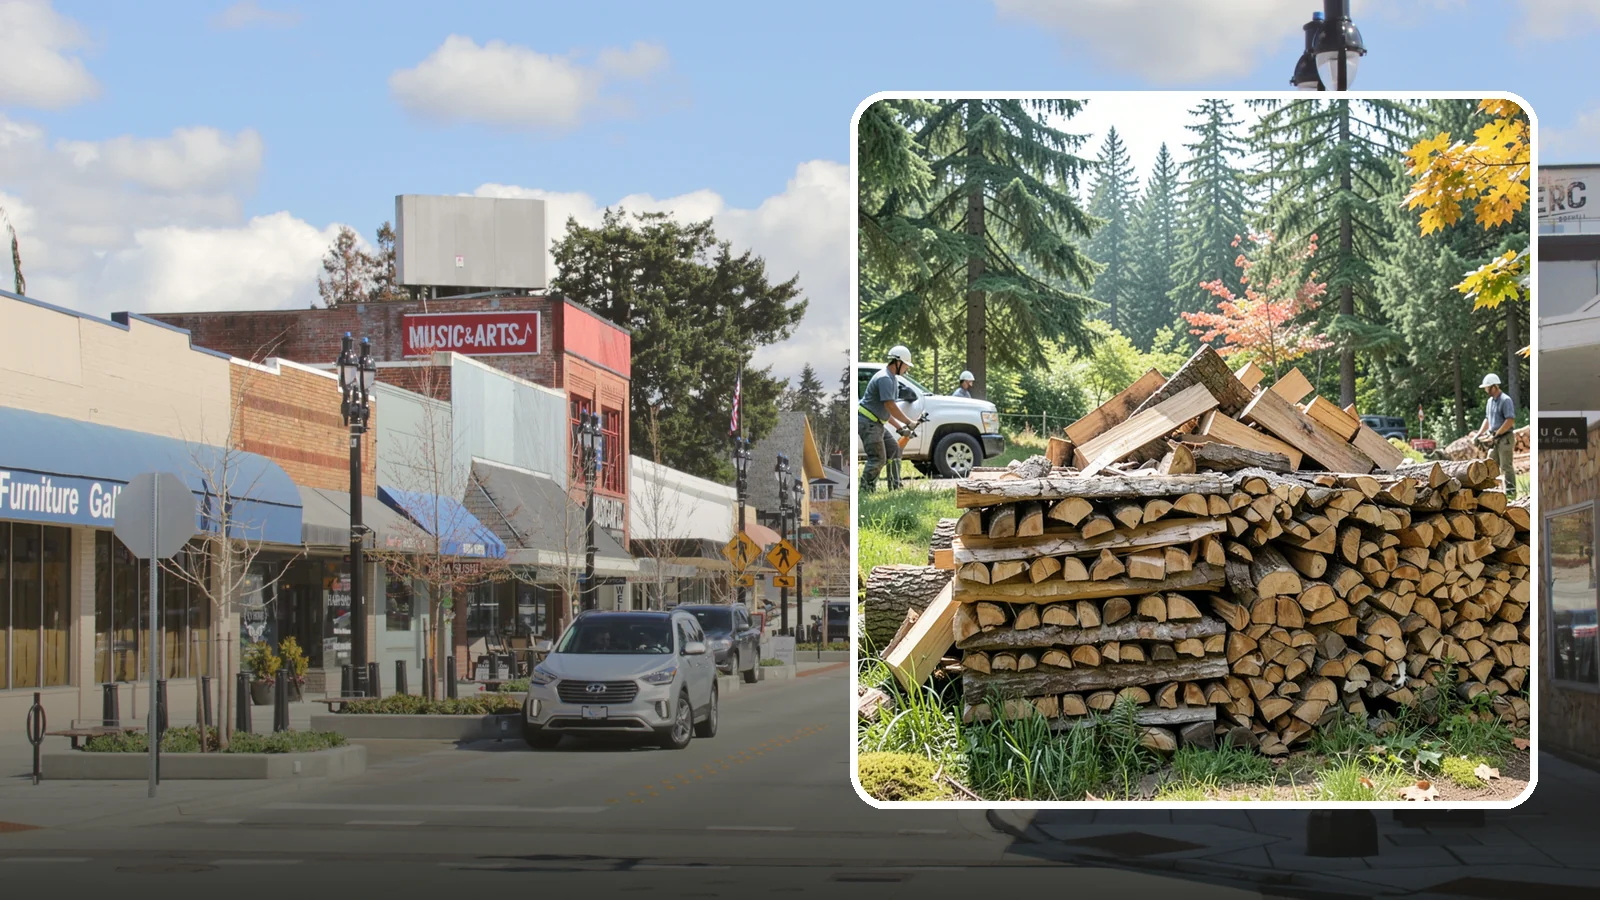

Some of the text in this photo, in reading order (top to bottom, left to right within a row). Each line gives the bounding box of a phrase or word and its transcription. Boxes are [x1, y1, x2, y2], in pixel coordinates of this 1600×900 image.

[0, 471, 121, 519] Furniture Gal
[453, 564, 479, 574] SUSHI
